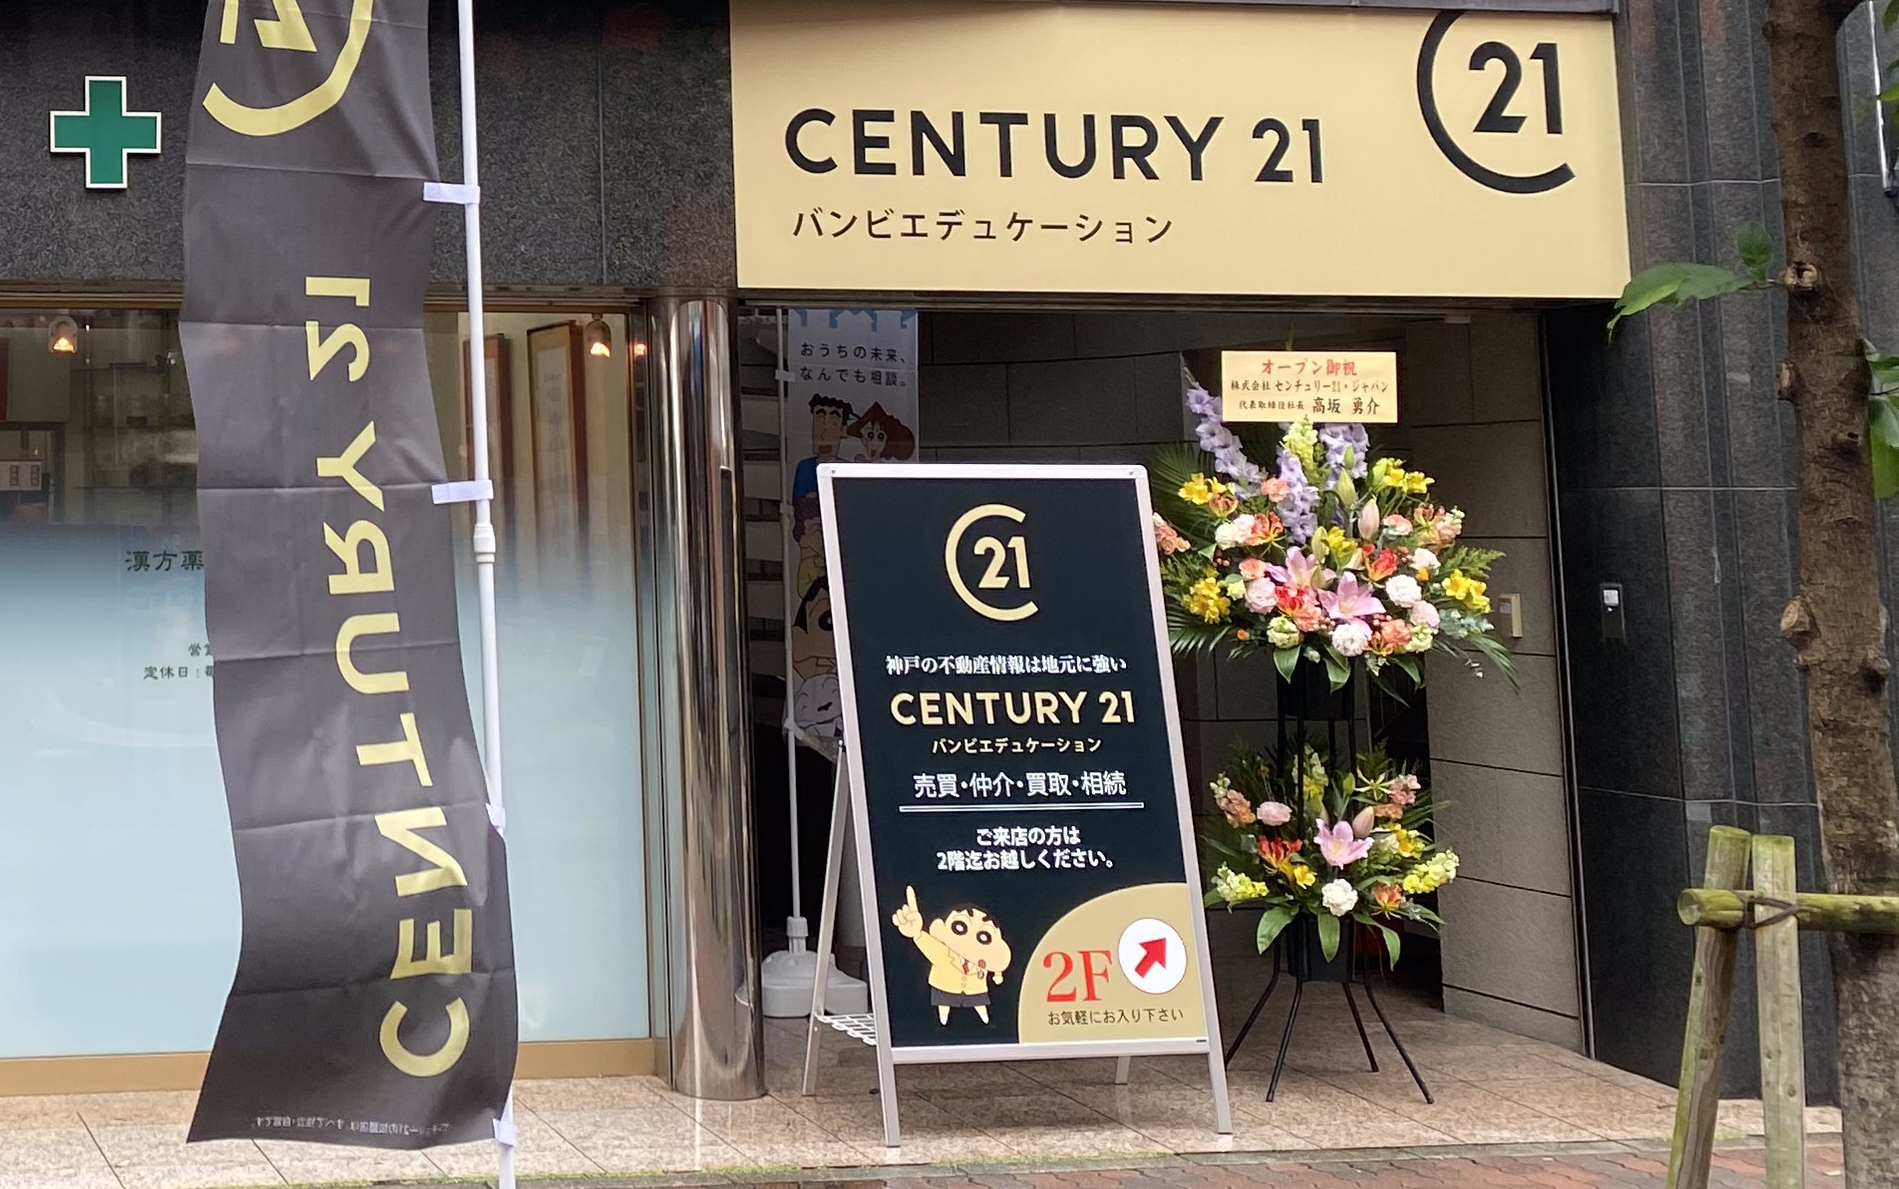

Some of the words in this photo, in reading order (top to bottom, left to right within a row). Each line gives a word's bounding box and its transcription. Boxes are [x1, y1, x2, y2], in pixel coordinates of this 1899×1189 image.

[785, 108, 1225, 182] CENTURY
[1251, 117, 1324, 184] 21
[791, 208, 1174, 244] バンビエデュケーション
[800, 342, 906, 364] おうちの未来、
[800, 366, 907, 388] なんでも相談。
[1262, 358, 1358, 377] オープン御祝
[1231, 379, 1271, 392] 株式会社
[885, 654, 1127, 676] 神戸の不動産情報は地元に強い
[890, 691, 1088, 726] CENTURY
[1099, 690, 1135, 724] 21
[932, 737, 1102, 754] バンビエデュケーション
[913, 771, 1127, 799] 売買・仲介・買取・相続
[976, 826, 1081, 847] ご来店の方は
[936, 849, 1115, 872] 2階迄お越しください。
[1043, 949, 1113, 1003] 2F
[1048, 1008, 1184, 1026] お気軽にお入り下さい
